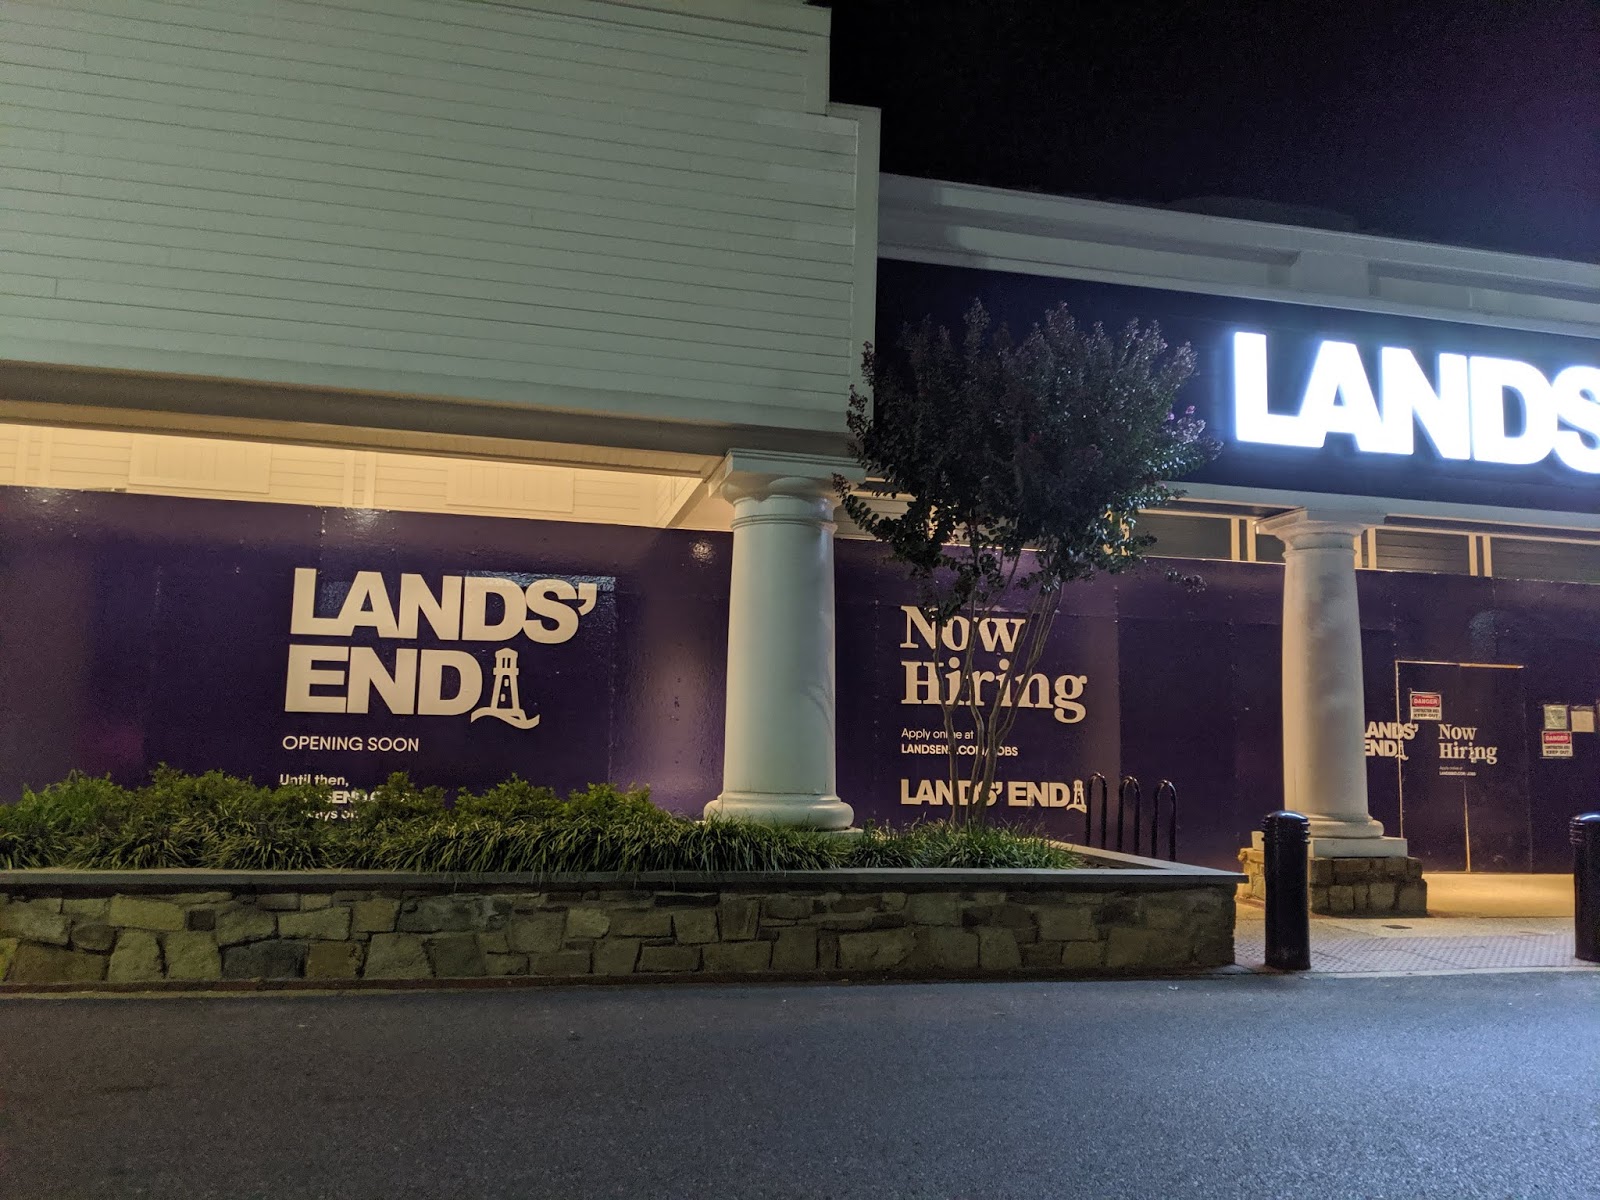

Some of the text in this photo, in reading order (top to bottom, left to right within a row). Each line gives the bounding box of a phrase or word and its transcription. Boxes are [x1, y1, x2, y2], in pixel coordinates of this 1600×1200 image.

[290, 567, 598, 644] LANDS'
[900, 605, 1026, 653] Now
[284, 644, 484, 716] END
[901, 656, 1088, 724] Hiring
[901, 728, 975, 740] Apply onlne at
[1365, 721, 1419, 740] ANDS'
[1438, 723, 1478, 741] Now
[282, 735, 419, 752] OPENING SOON
[901, 743, 1019, 757] LANDSEN.COM/OBS
[1438, 743, 1498, 765] Hiring
[279, 773, 349, 787] Until then,
[901, 778, 1071, 808] LANDS' END
